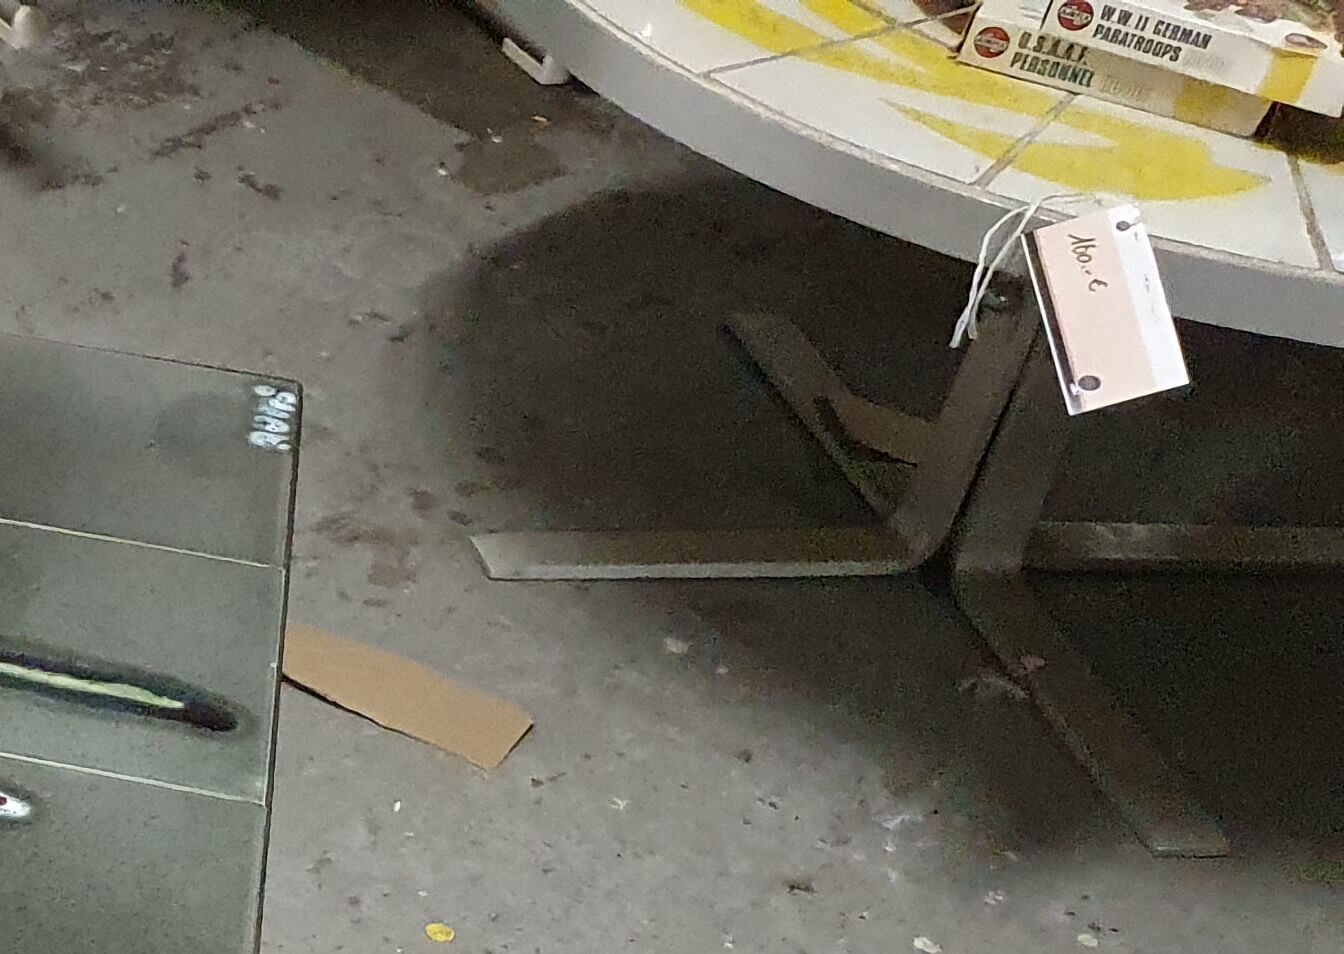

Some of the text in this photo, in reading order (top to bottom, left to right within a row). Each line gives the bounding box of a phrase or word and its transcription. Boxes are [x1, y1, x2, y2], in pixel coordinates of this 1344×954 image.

[1092, 23, 1183, 62] PARATROOPS
[1152, 19, 1213, 50] GERMAN
[1010, 51, 1095, 88] PERSONNEL
